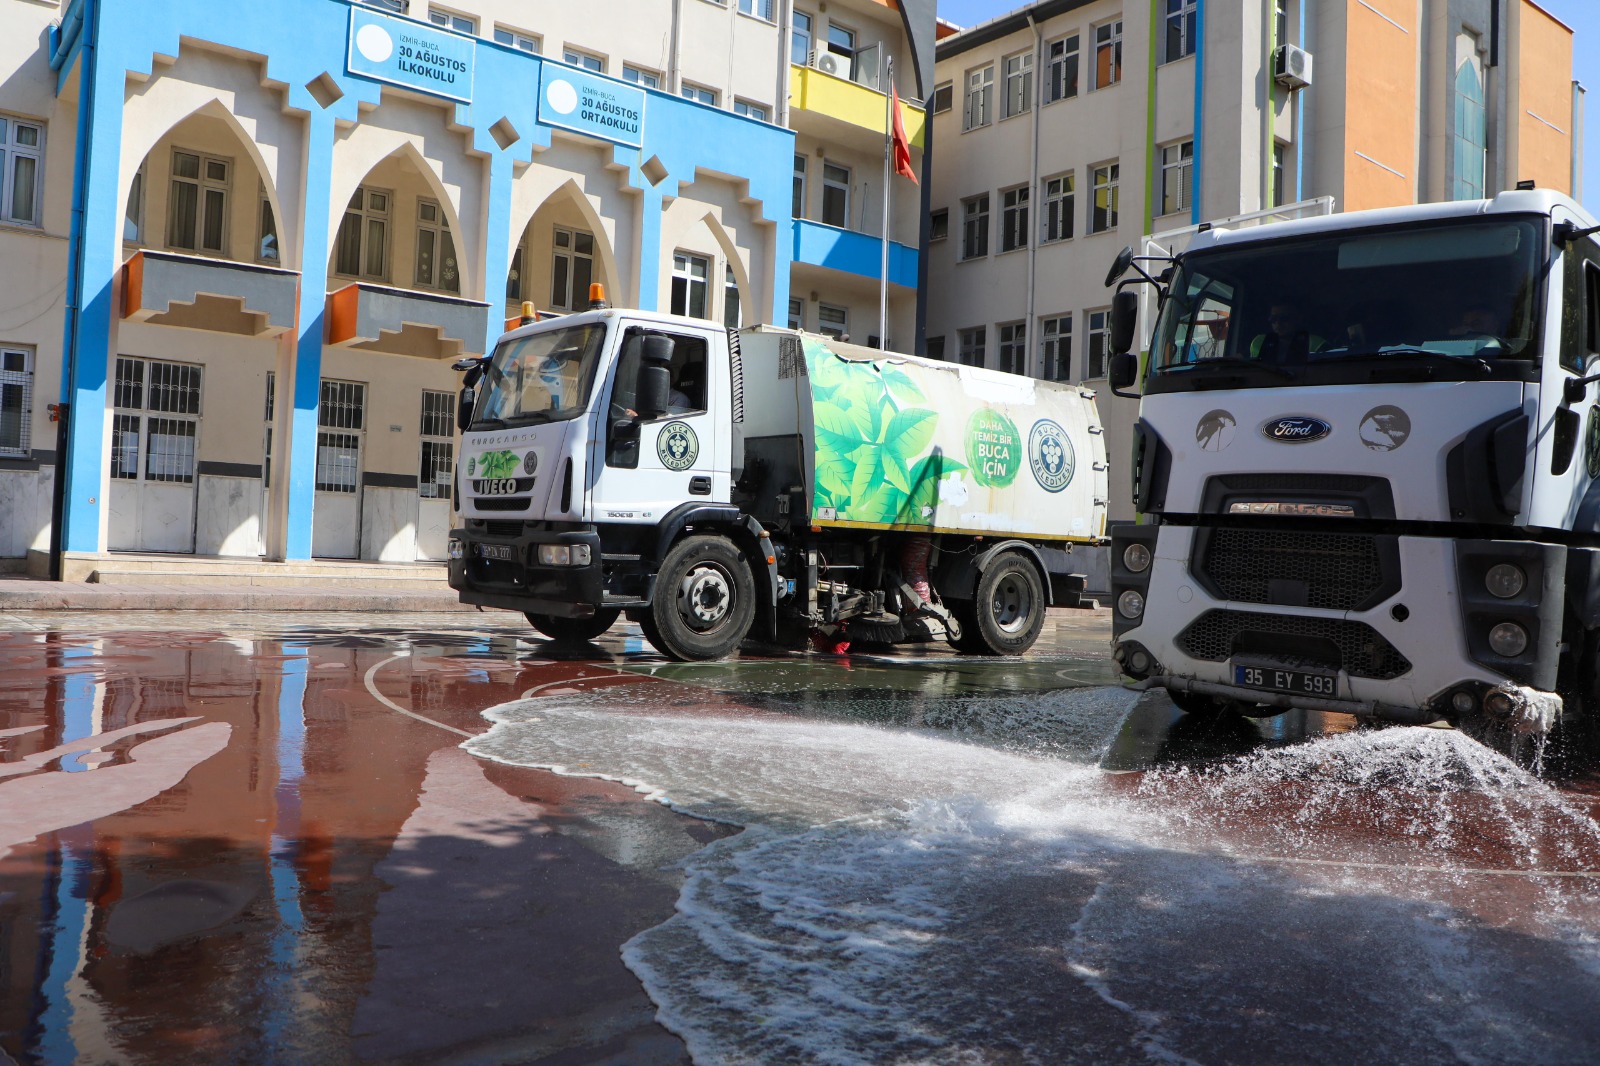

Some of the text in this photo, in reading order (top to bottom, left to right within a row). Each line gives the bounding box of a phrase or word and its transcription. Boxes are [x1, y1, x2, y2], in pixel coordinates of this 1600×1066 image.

[399, 45, 466, 72] 30 AĞUSTOS
[398, 57, 455, 83] İLKOKULU
[582, 96, 638, 121] 30 AĞUSTOS
[581, 110, 638, 133] ORTAOKULU
[667, 426, 688, 435] BUCA
[980, 420, 1003, 432] DAHA
[1037, 425, 1061, 438] BUCA
[1274, 420, 1312, 436] Ford
[973, 431, 1012, 445] TEMİZ BİR
[978, 443, 1010, 460] BUCA
[982, 458, 1006, 479] İÇİN
[479, 478, 517, 496] IVECO
[1245, 668, 1333, 694] 35 EY 593
